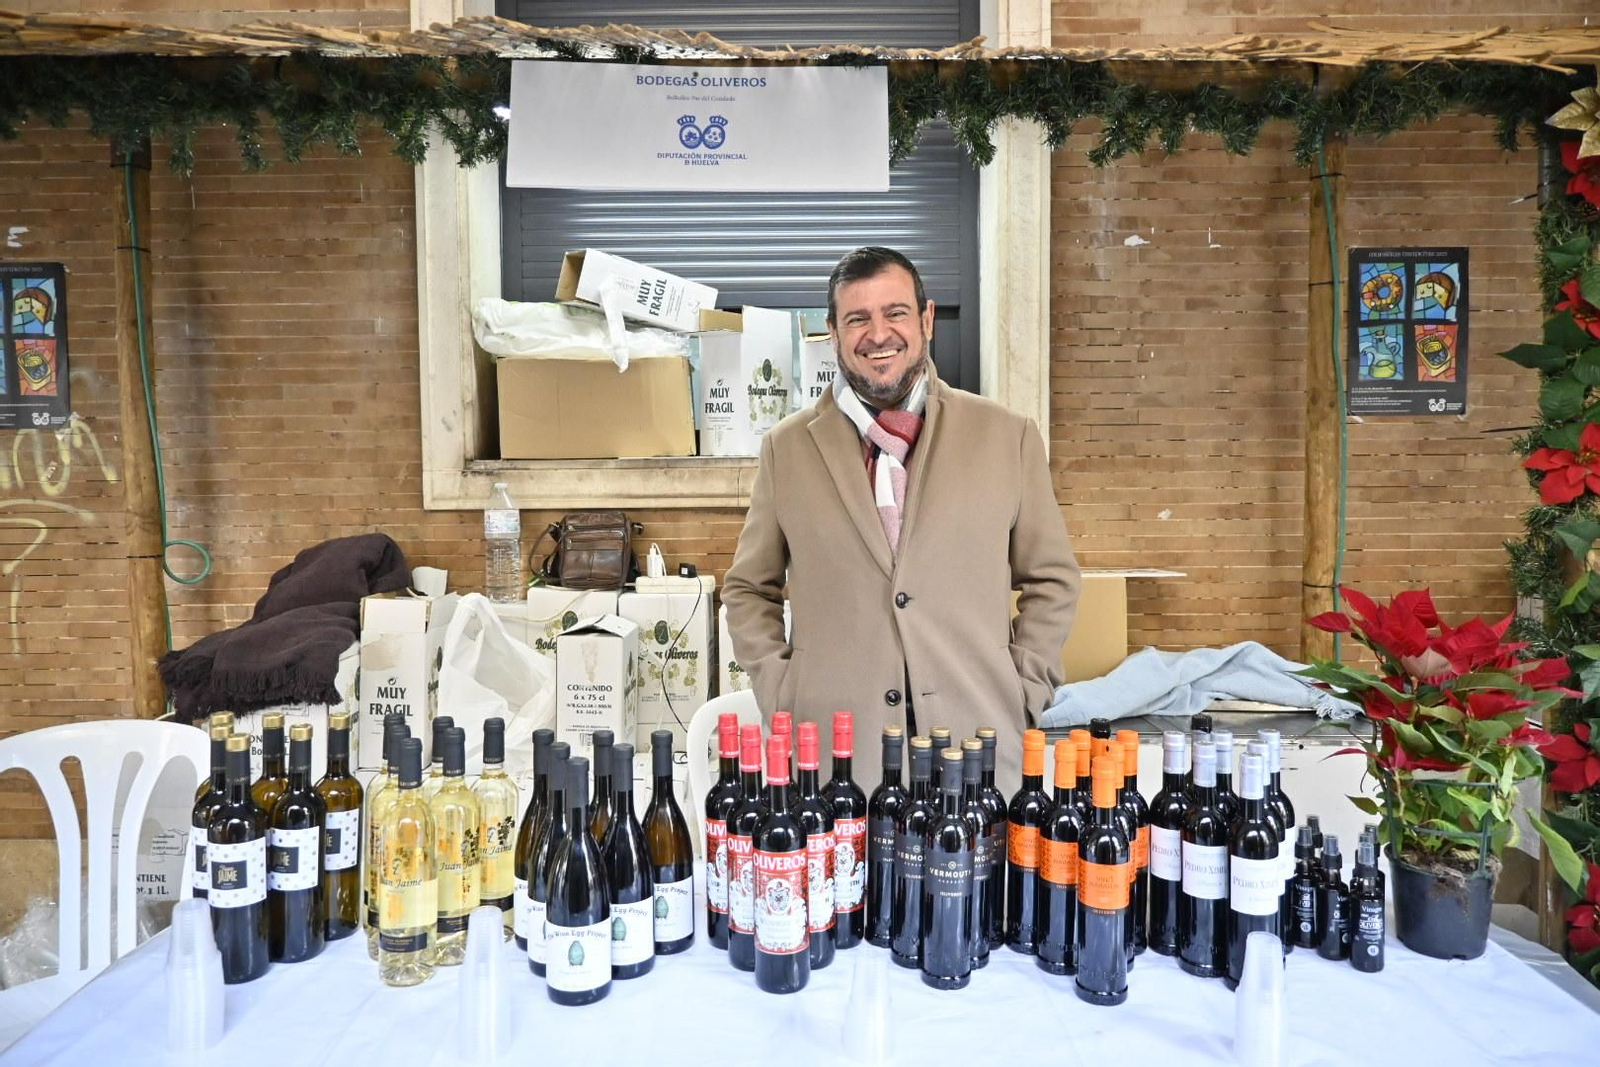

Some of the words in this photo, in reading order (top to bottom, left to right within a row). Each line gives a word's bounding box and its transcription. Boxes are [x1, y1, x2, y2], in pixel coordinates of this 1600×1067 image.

[636, 75, 698, 87] BODEGAS
[700, 77, 767, 88] OLIVEROS
[657, 152, 702, 160] DIPUTACIÓN
[636, 278, 653, 306] MUY
[648, 278, 668, 317] FRAGIL
[817, 370, 836, 383] MU
[709, 386, 730, 399] MUY
[704, 402, 735, 414] FRAGIL
[535, 637, 557, 653] Bode
[376, 686, 407, 700] MUY
[573, 693, 579, 701] 6
[588, 693, 597, 701] 75
[598, 694, 606, 702] cl
[369, 702, 414, 717] FRAGIL
[705, 820, 727, 837] OLIV
[727, 837, 753, 854] OLIV
[873, 836, 894, 846] VERM
[753, 852, 806, 871] OLIVEROS
[897, 850, 924, 862] VERMO
